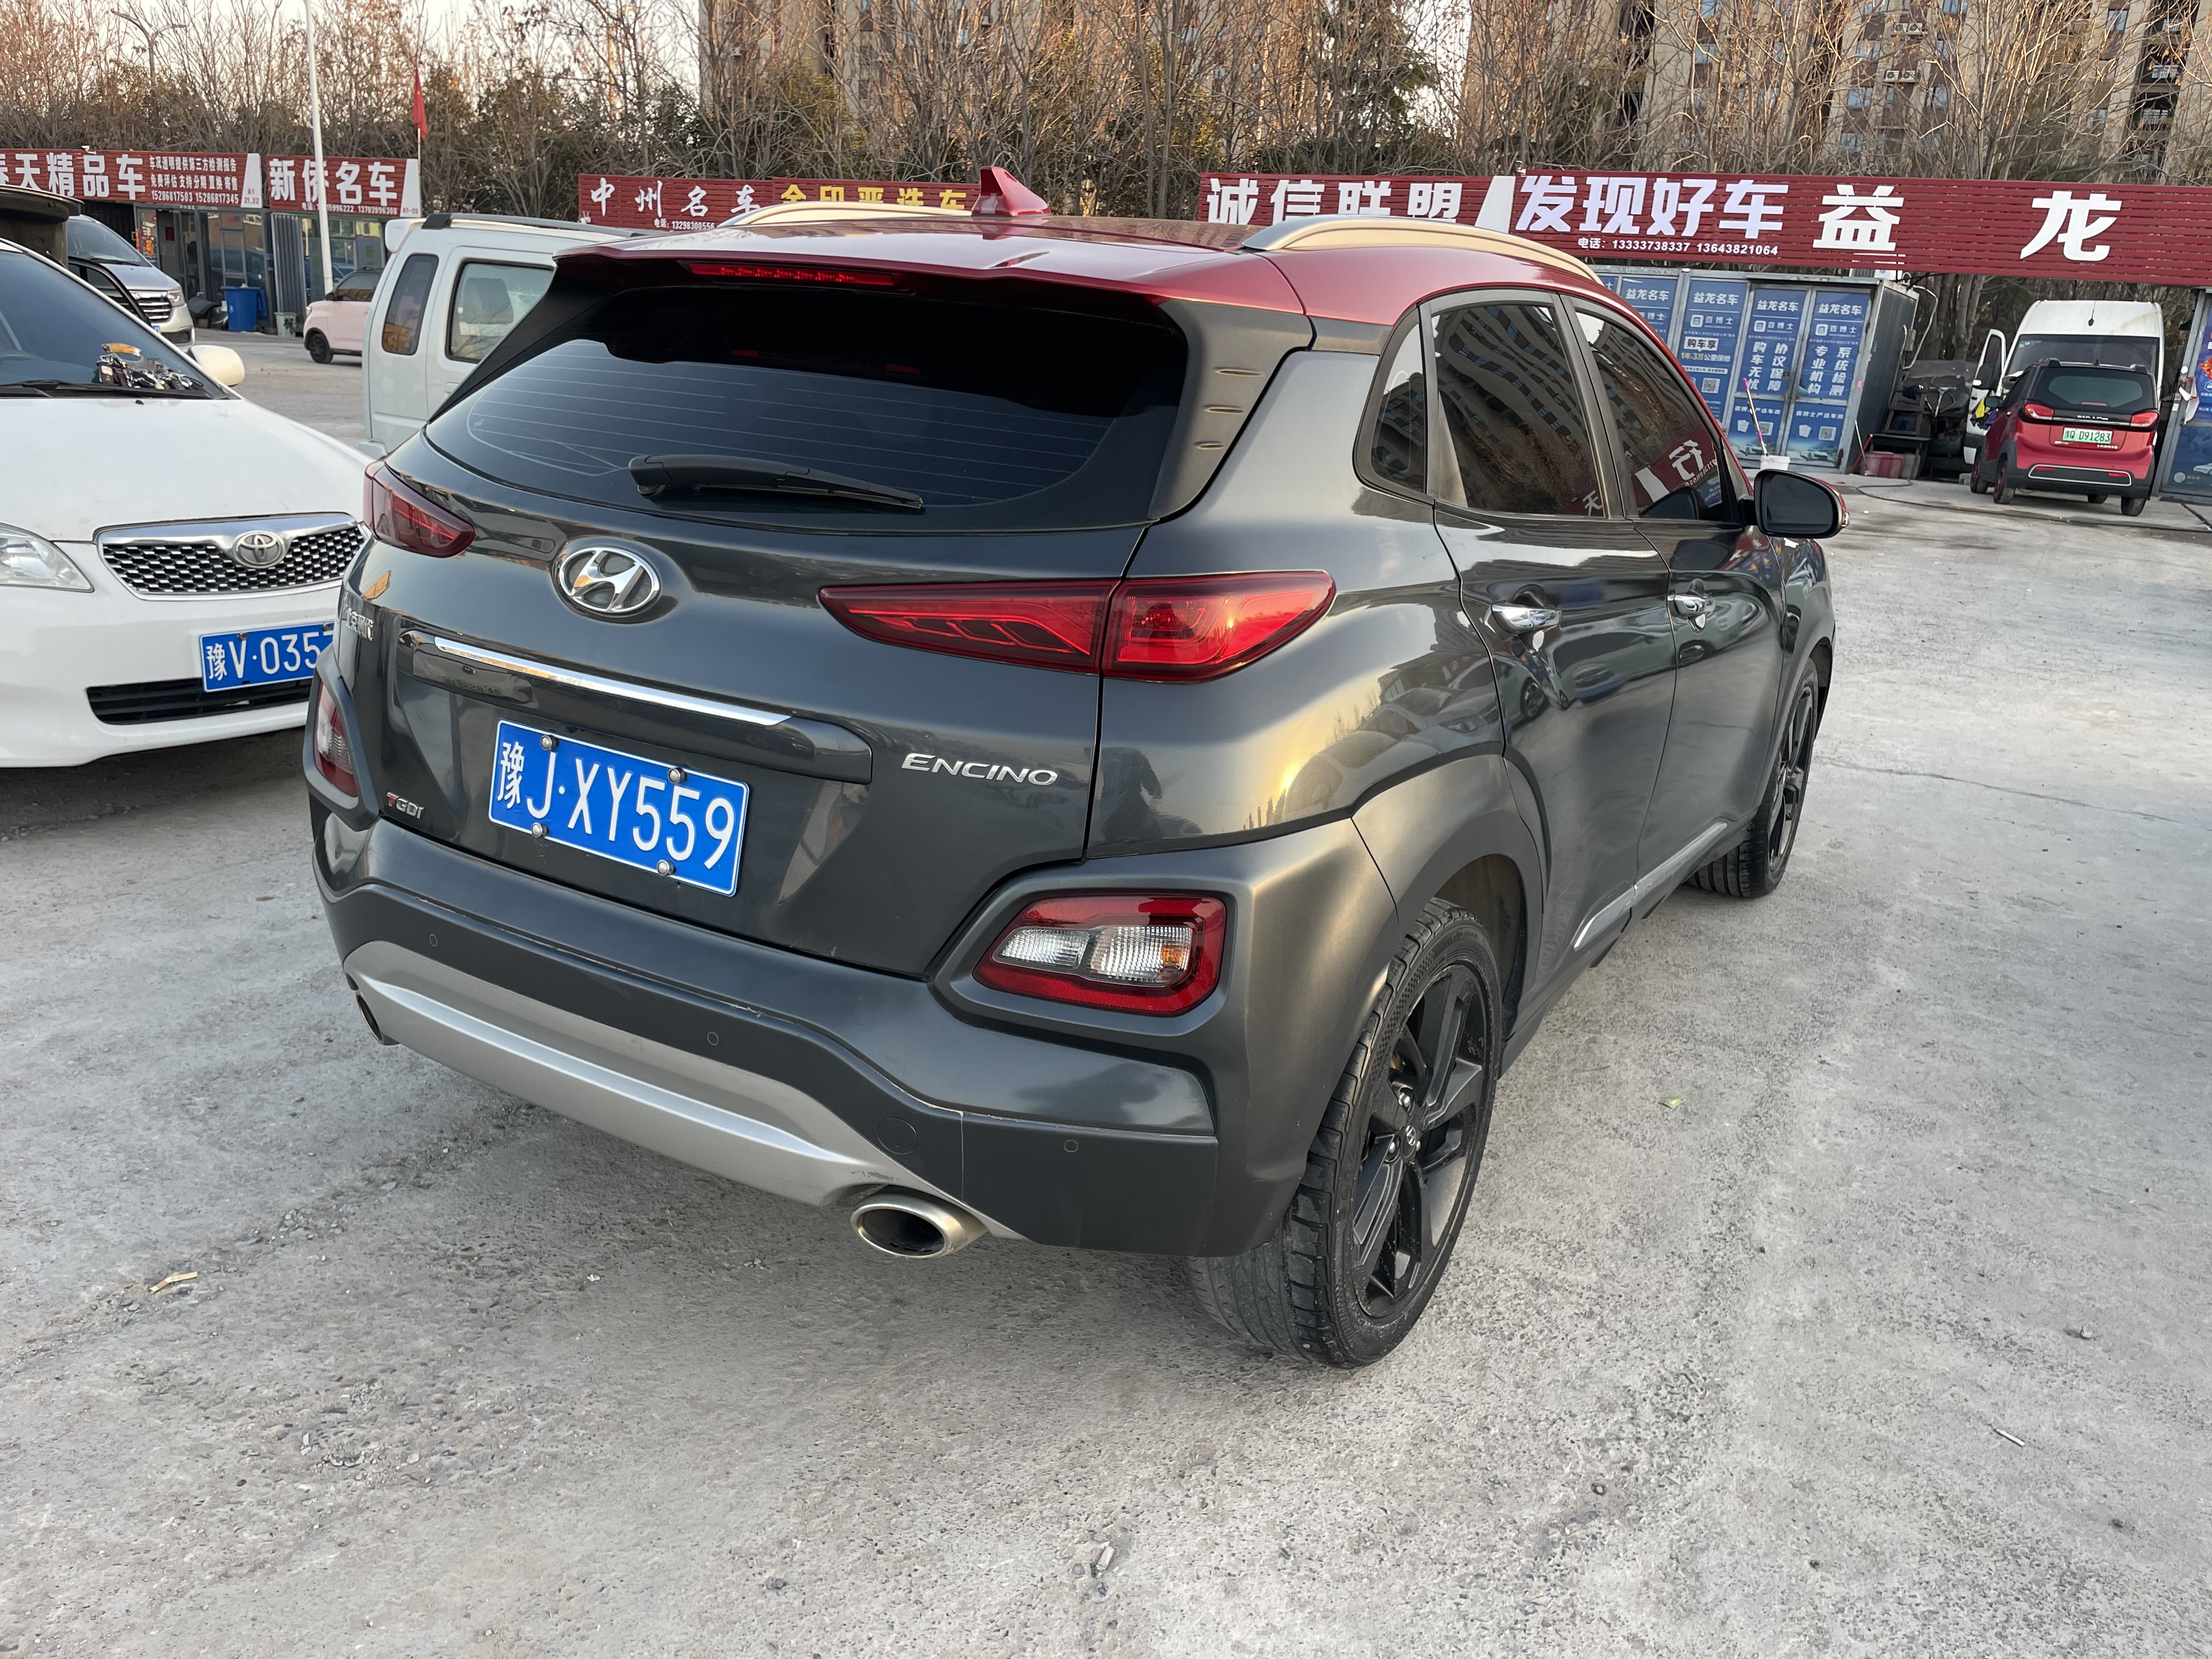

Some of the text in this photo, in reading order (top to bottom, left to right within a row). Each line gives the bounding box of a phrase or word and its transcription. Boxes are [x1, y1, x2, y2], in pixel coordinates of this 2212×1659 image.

[590, 177, 761, 218] 中州名车
[1206, 178, 1463, 225] 诚信联盟
[1515, 176, 1790, 239] 发现好车
[1612, 239, 1690, 253] 13333738337
[1696, 242, 1779, 256] 13643821064
[1626, 288, 1669, 301] 益龙名车
[1693, 292, 1739, 306] 益龙名车
[1756, 300, 1799, 312] 益龙名车
[1818, 303, 1862, 315] 益龙名车
[1807, 345, 1829, 395] 专业机构
[1829, 347, 1852, 396] 系统检测
[2079, 431, 2111, 442] D91283
[901, 752, 1059, 786] ENCINO
